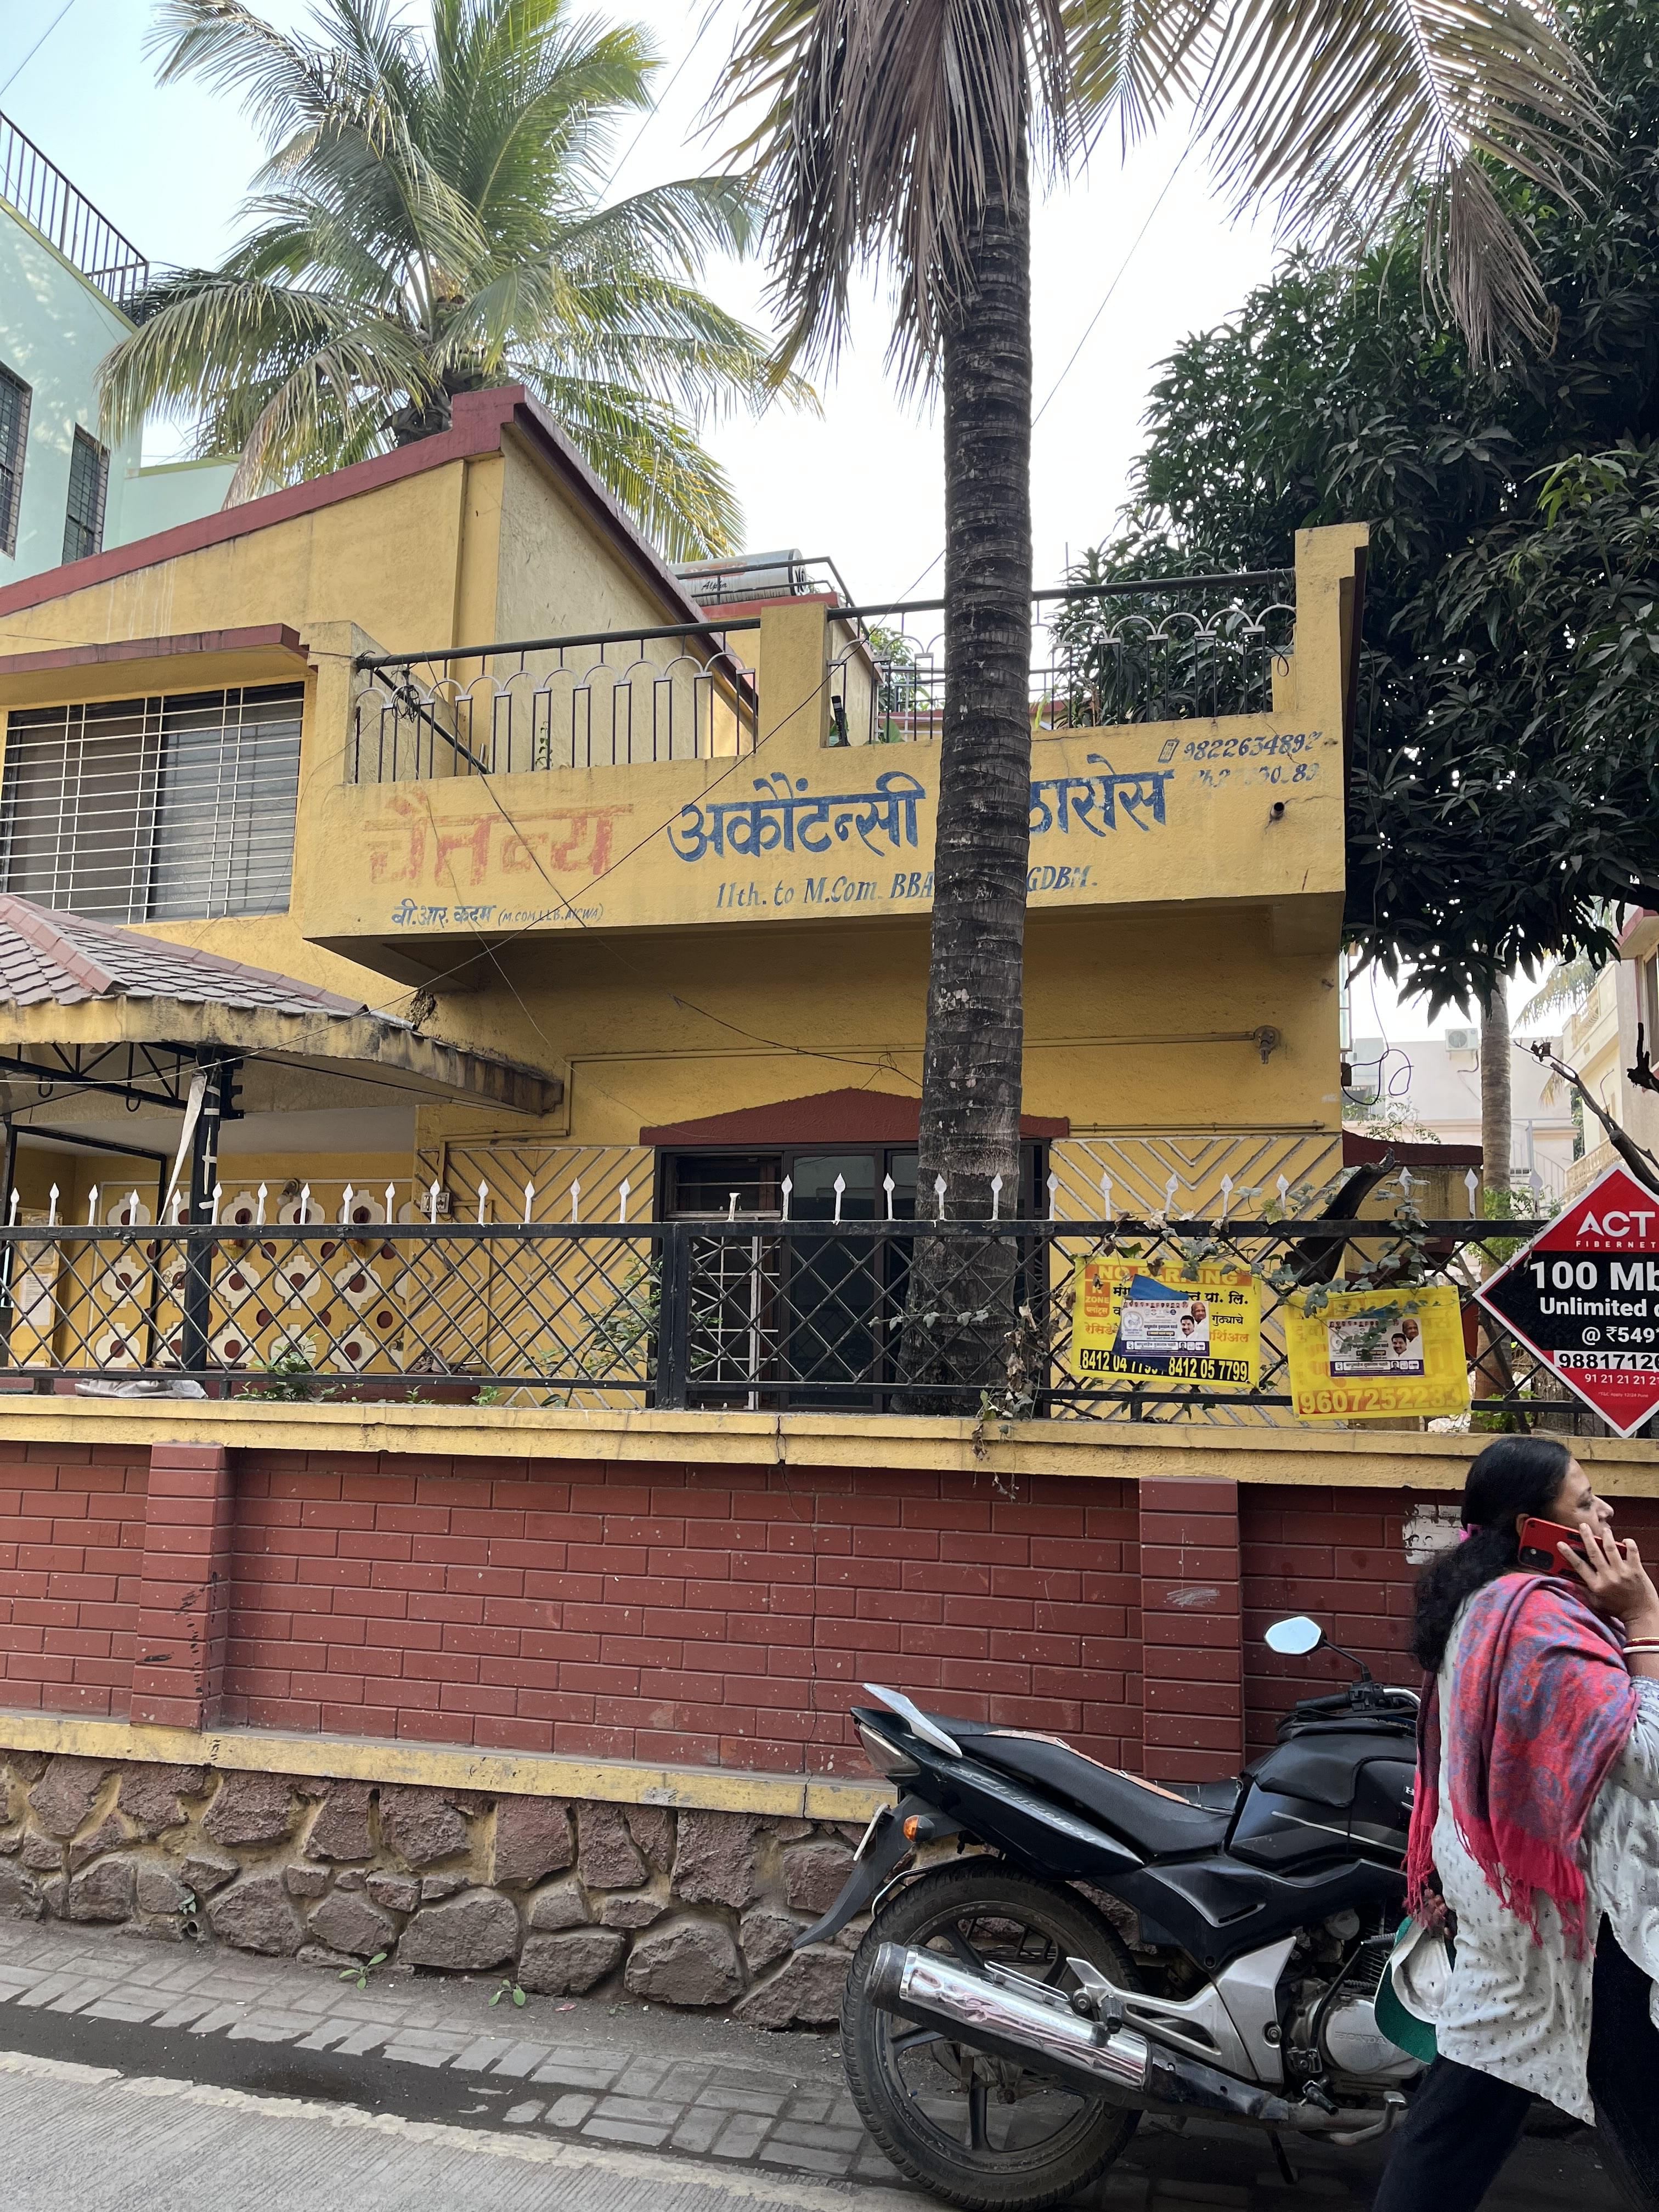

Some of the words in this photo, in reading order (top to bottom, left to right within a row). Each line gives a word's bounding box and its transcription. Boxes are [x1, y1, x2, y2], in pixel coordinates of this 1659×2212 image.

[774, 880, 794, 906] to
[1576, 1211, 1656, 1237] ACT
[1098, 1266, 1130, 1280] NO
[1530, 1261, 1598, 1290] 100
[1540, 1297, 1647, 1317] Unlimited
[1582, 1327, 1601, 1345] @
[1082, 1350, 1110, 1370] 8412
[1168, 1356, 1197, 1378] 8412
[1200, 1359, 1215, 1379] 05
[1218, 1360, 1248, 1381] 7799
[1559, 1353, 1659, 1370] 9881712
[1584, 1373, 1598, 1383] 91
[1601, 1374, 1613, 1384] 21
[1617, 1375, 1629, 1384] 21
[1633, 1375, 1646, 1385] 21
